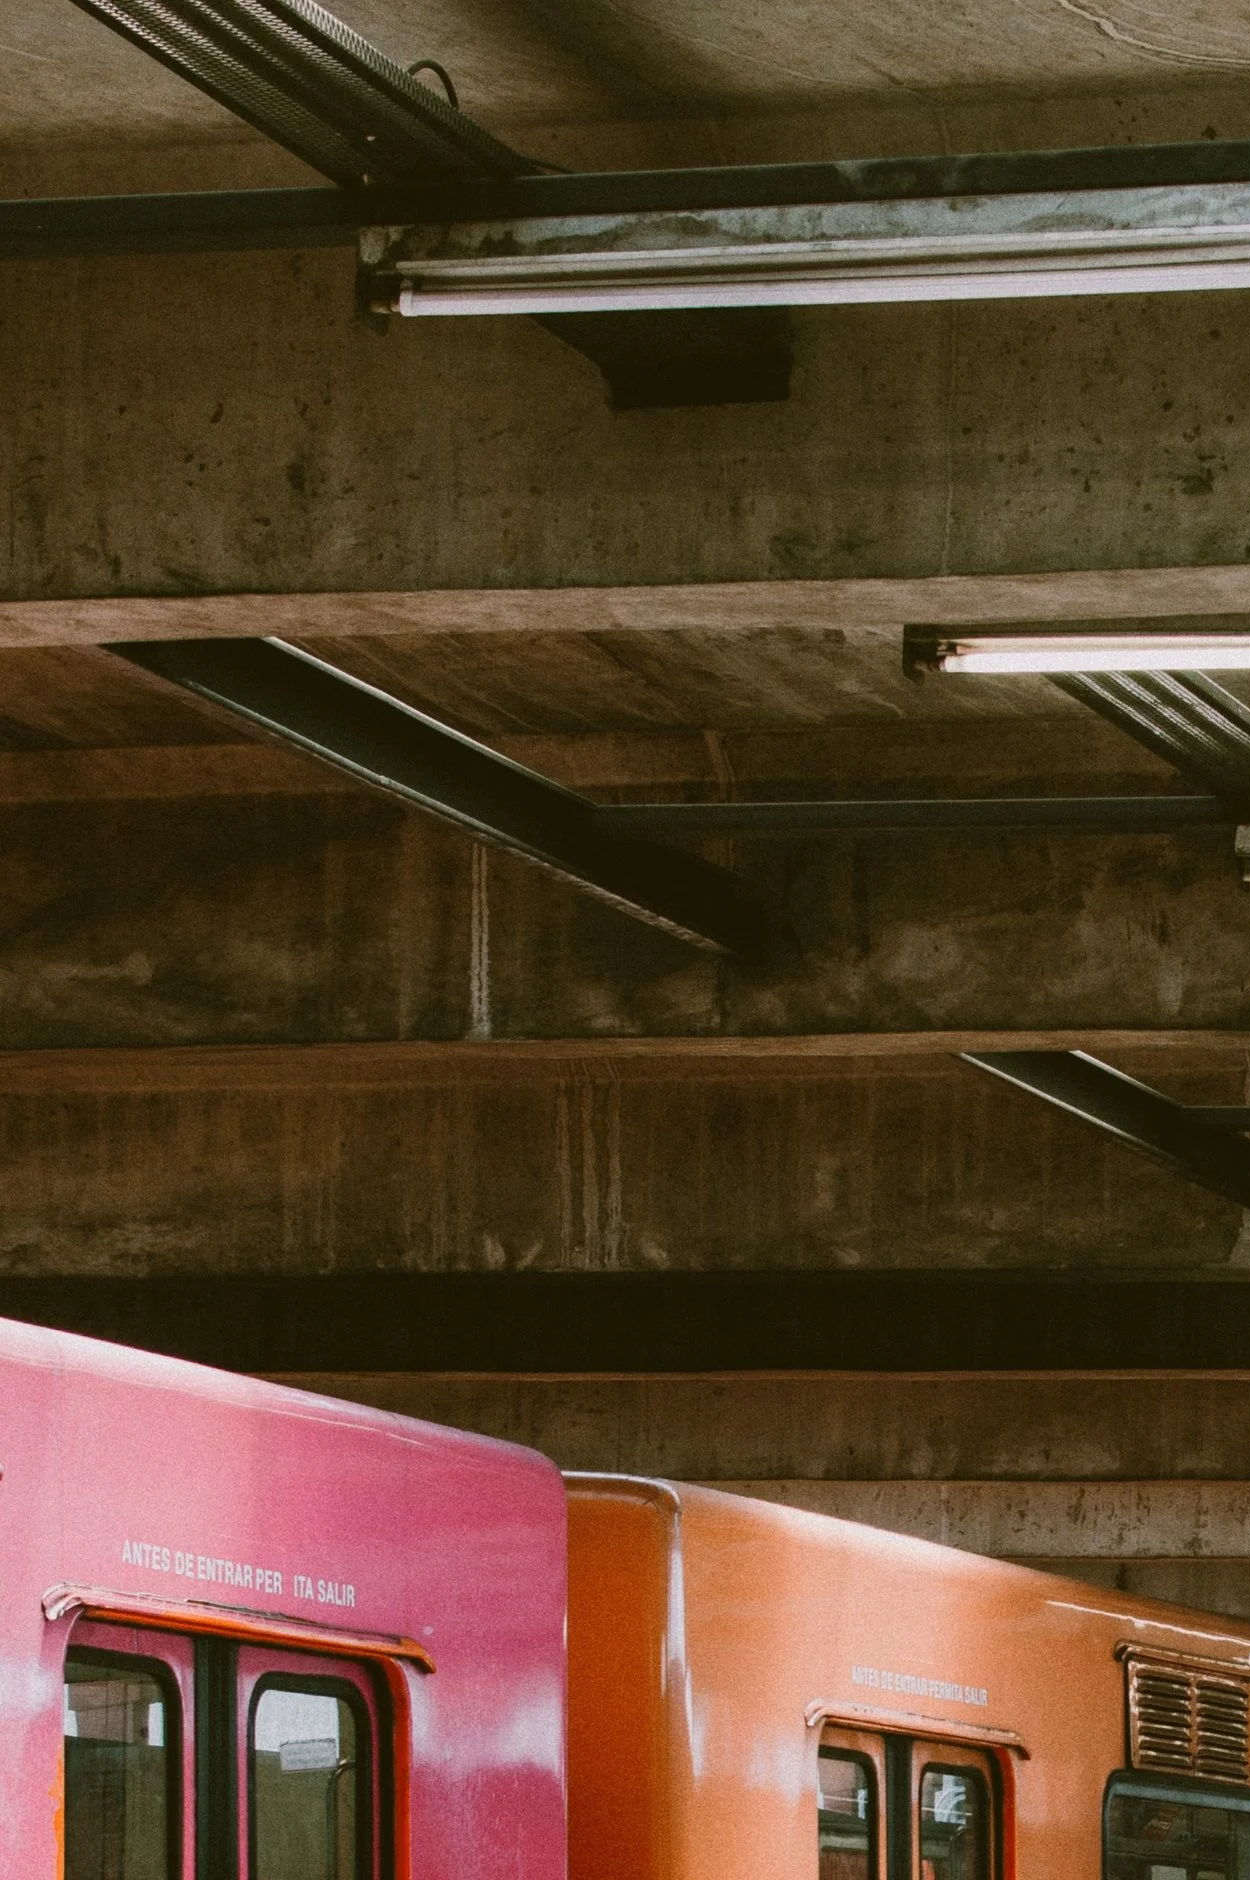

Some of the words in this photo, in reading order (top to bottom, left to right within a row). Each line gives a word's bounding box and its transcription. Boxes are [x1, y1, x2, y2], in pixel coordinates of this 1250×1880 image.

[122, 1538, 171, 1573] ANTES
[174, 1550, 195, 1578] DE
[197, 1555, 253, 1589] ENTRAR
[317, 1578, 356, 1608] SALIR
[852, 1665, 879, 1686] ANTES
[881, 1670, 893, 1689] DE
[964, 1686, 988, 1706] SALIR
